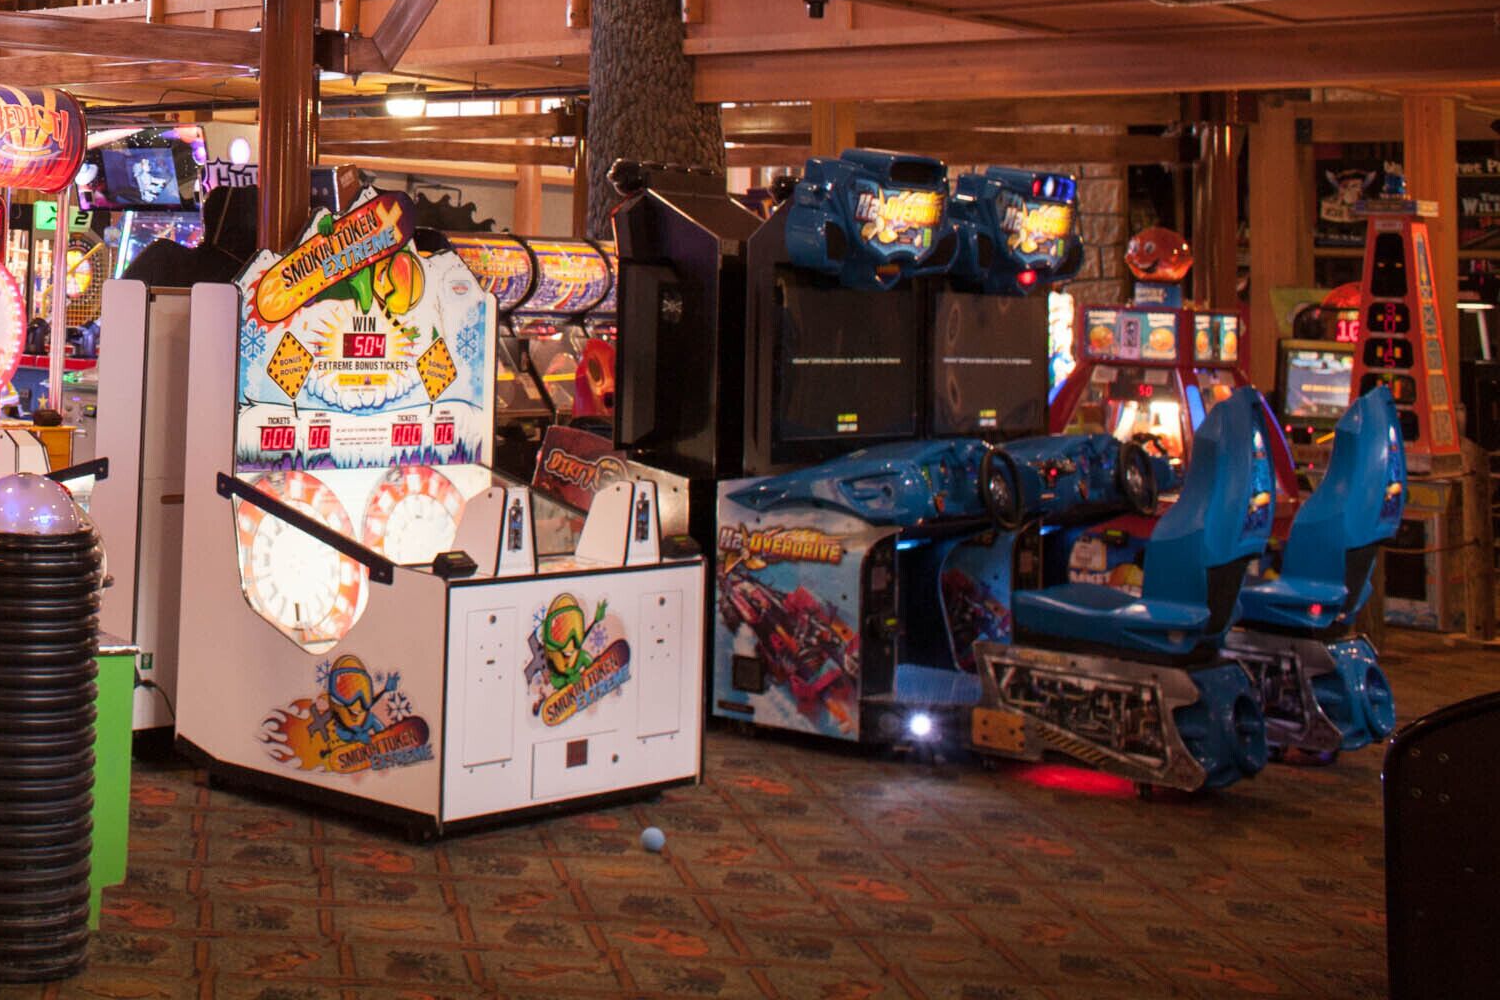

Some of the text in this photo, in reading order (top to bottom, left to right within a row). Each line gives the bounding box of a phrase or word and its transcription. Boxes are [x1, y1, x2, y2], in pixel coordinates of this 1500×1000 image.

[336, 207, 379, 250] TOKEN
[321, 227, 397, 279] EXTREME
[352, 316, 376, 332] WIN
[279, 356, 302, 367] BONUS
[280, 367, 303, 377] ROUND
[318, 361, 409, 370] EXTREME BONUS TICKETS
[268, 417, 290, 425] TICKETS
[261, 427, 295, 450] 000
[309, 427, 331, 449] 00
[392, 424, 422, 446] 000
[434, 424, 454, 445] 00
[547, 450, 598, 489] DIRTY
[380, 731, 418, 751] TOKEN
